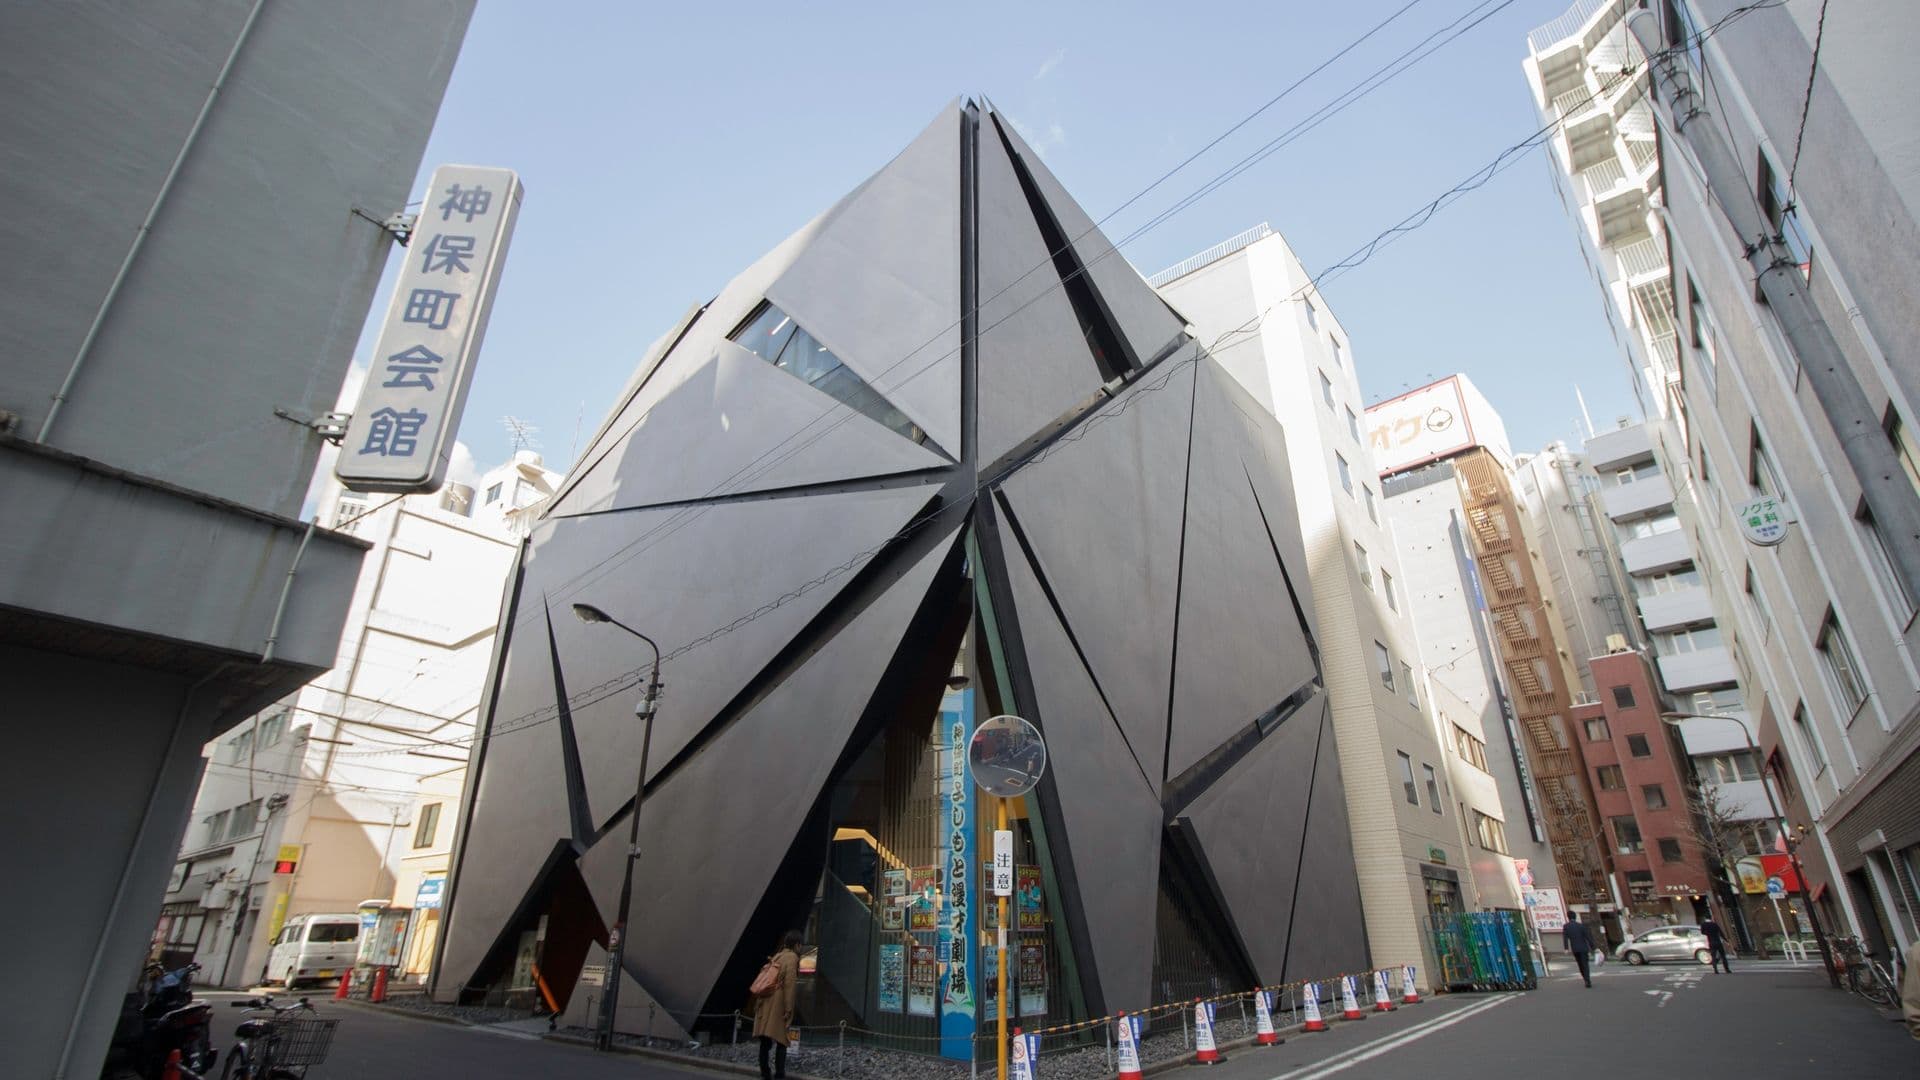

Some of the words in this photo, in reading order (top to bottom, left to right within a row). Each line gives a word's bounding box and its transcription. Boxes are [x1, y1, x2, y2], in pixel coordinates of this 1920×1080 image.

[357, 183, 493, 458] 神保町会館
[1741, 501, 1776, 516] ノグチ
[1747, 511, 1779, 528] 歯科
[951, 722, 965, 995] 神保町よしもと漫才劇場
[997, 852, 1011, 890] 注意
